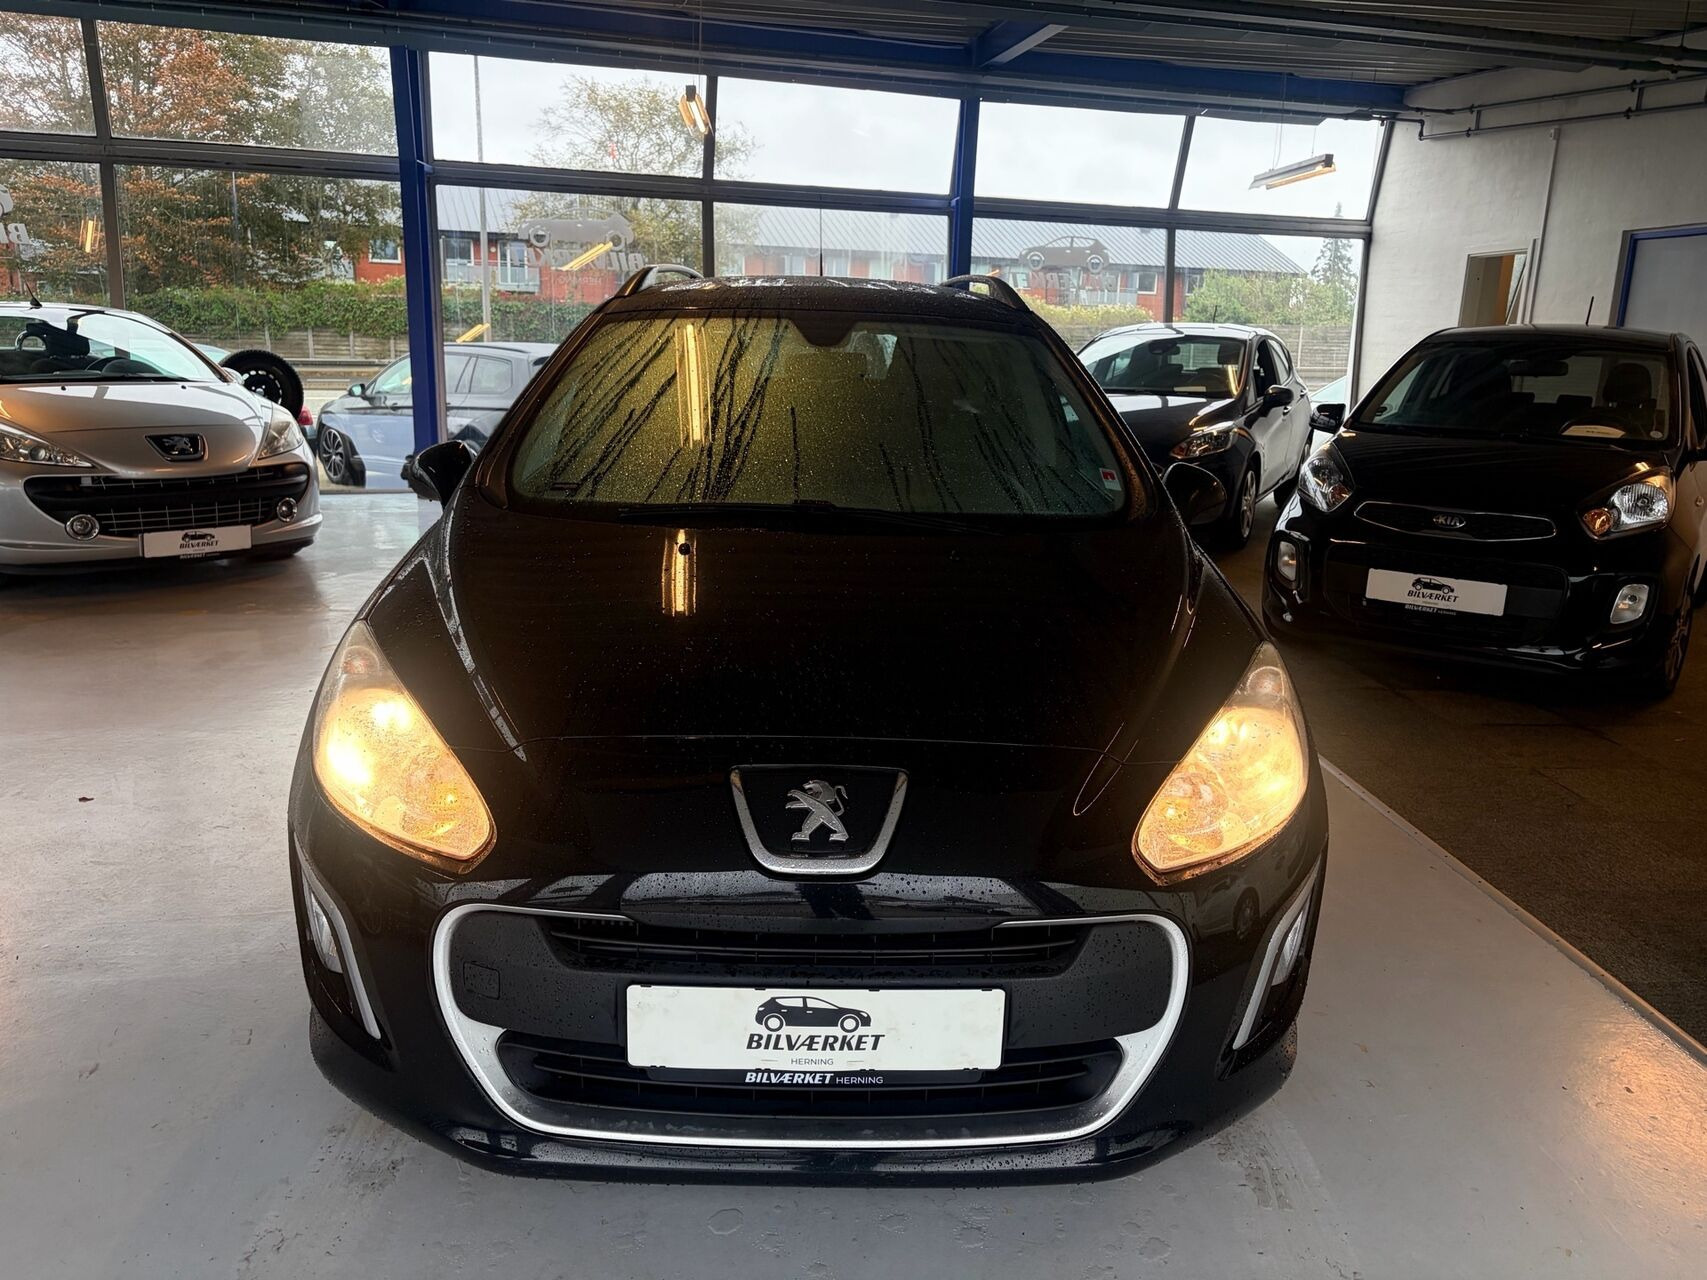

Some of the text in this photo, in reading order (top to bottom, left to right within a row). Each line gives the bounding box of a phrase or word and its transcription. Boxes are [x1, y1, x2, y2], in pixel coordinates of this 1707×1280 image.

[1438, 514, 1460, 526] KIA
[1407, 589, 1459, 603] BILVÆRKET
[746, 1033, 885, 1051] BILVÆRKET
[790, 1058, 834, 1066] HERNING
[745, 1072, 884, 1085] BILVÆRKET HERNING
